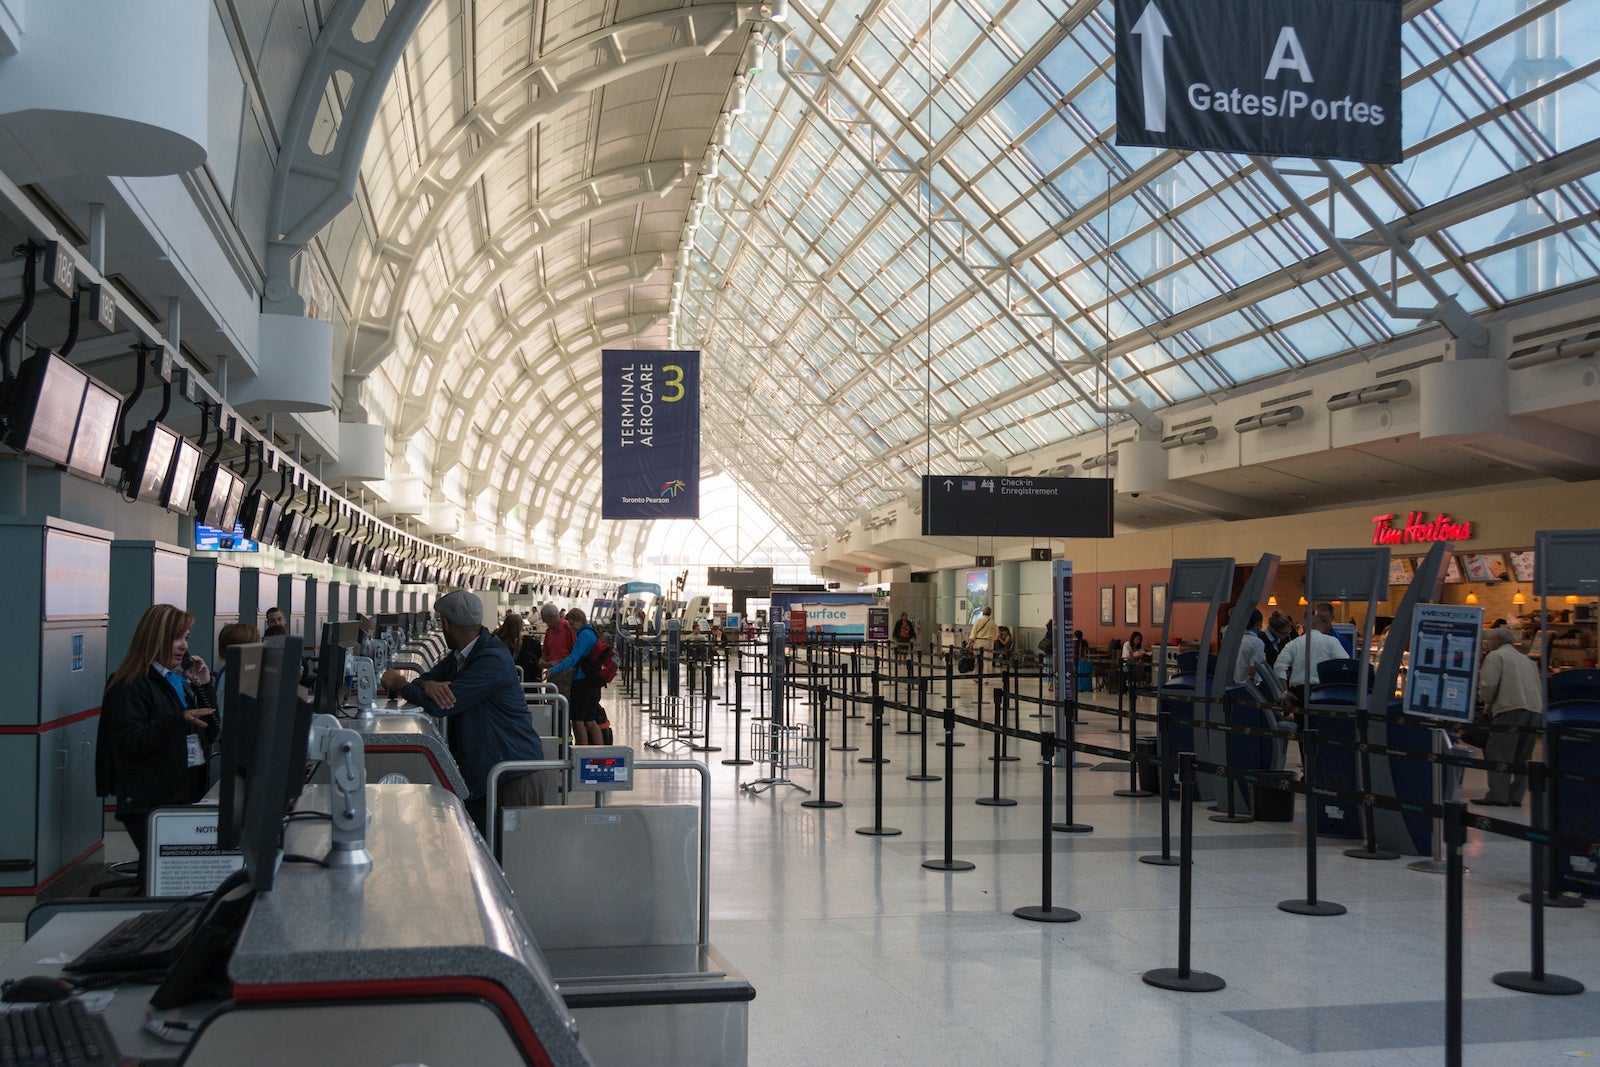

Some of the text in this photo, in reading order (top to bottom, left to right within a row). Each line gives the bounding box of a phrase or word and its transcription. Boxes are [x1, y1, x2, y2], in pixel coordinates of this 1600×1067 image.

[1264, 26, 1314, 83] A
[1187, 82, 1385, 126] Gates/Portes
[58, 254, 72, 288] 186
[102, 294, 113, 324] 185
[661, 364, 685, 402] 3
[621, 363, 635, 447] TERMINAL
[637, 363, 654, 447] AÉROGARE
[1001, 478, 1033, 486] Check-in
[1001, 487, 1058, 496] Enregistrement
[622, 496, 669, 504] Toronto Pearson
[1371, 511, 1470, 545] Tim Hortons
[805, 608, 847, 619] surface
